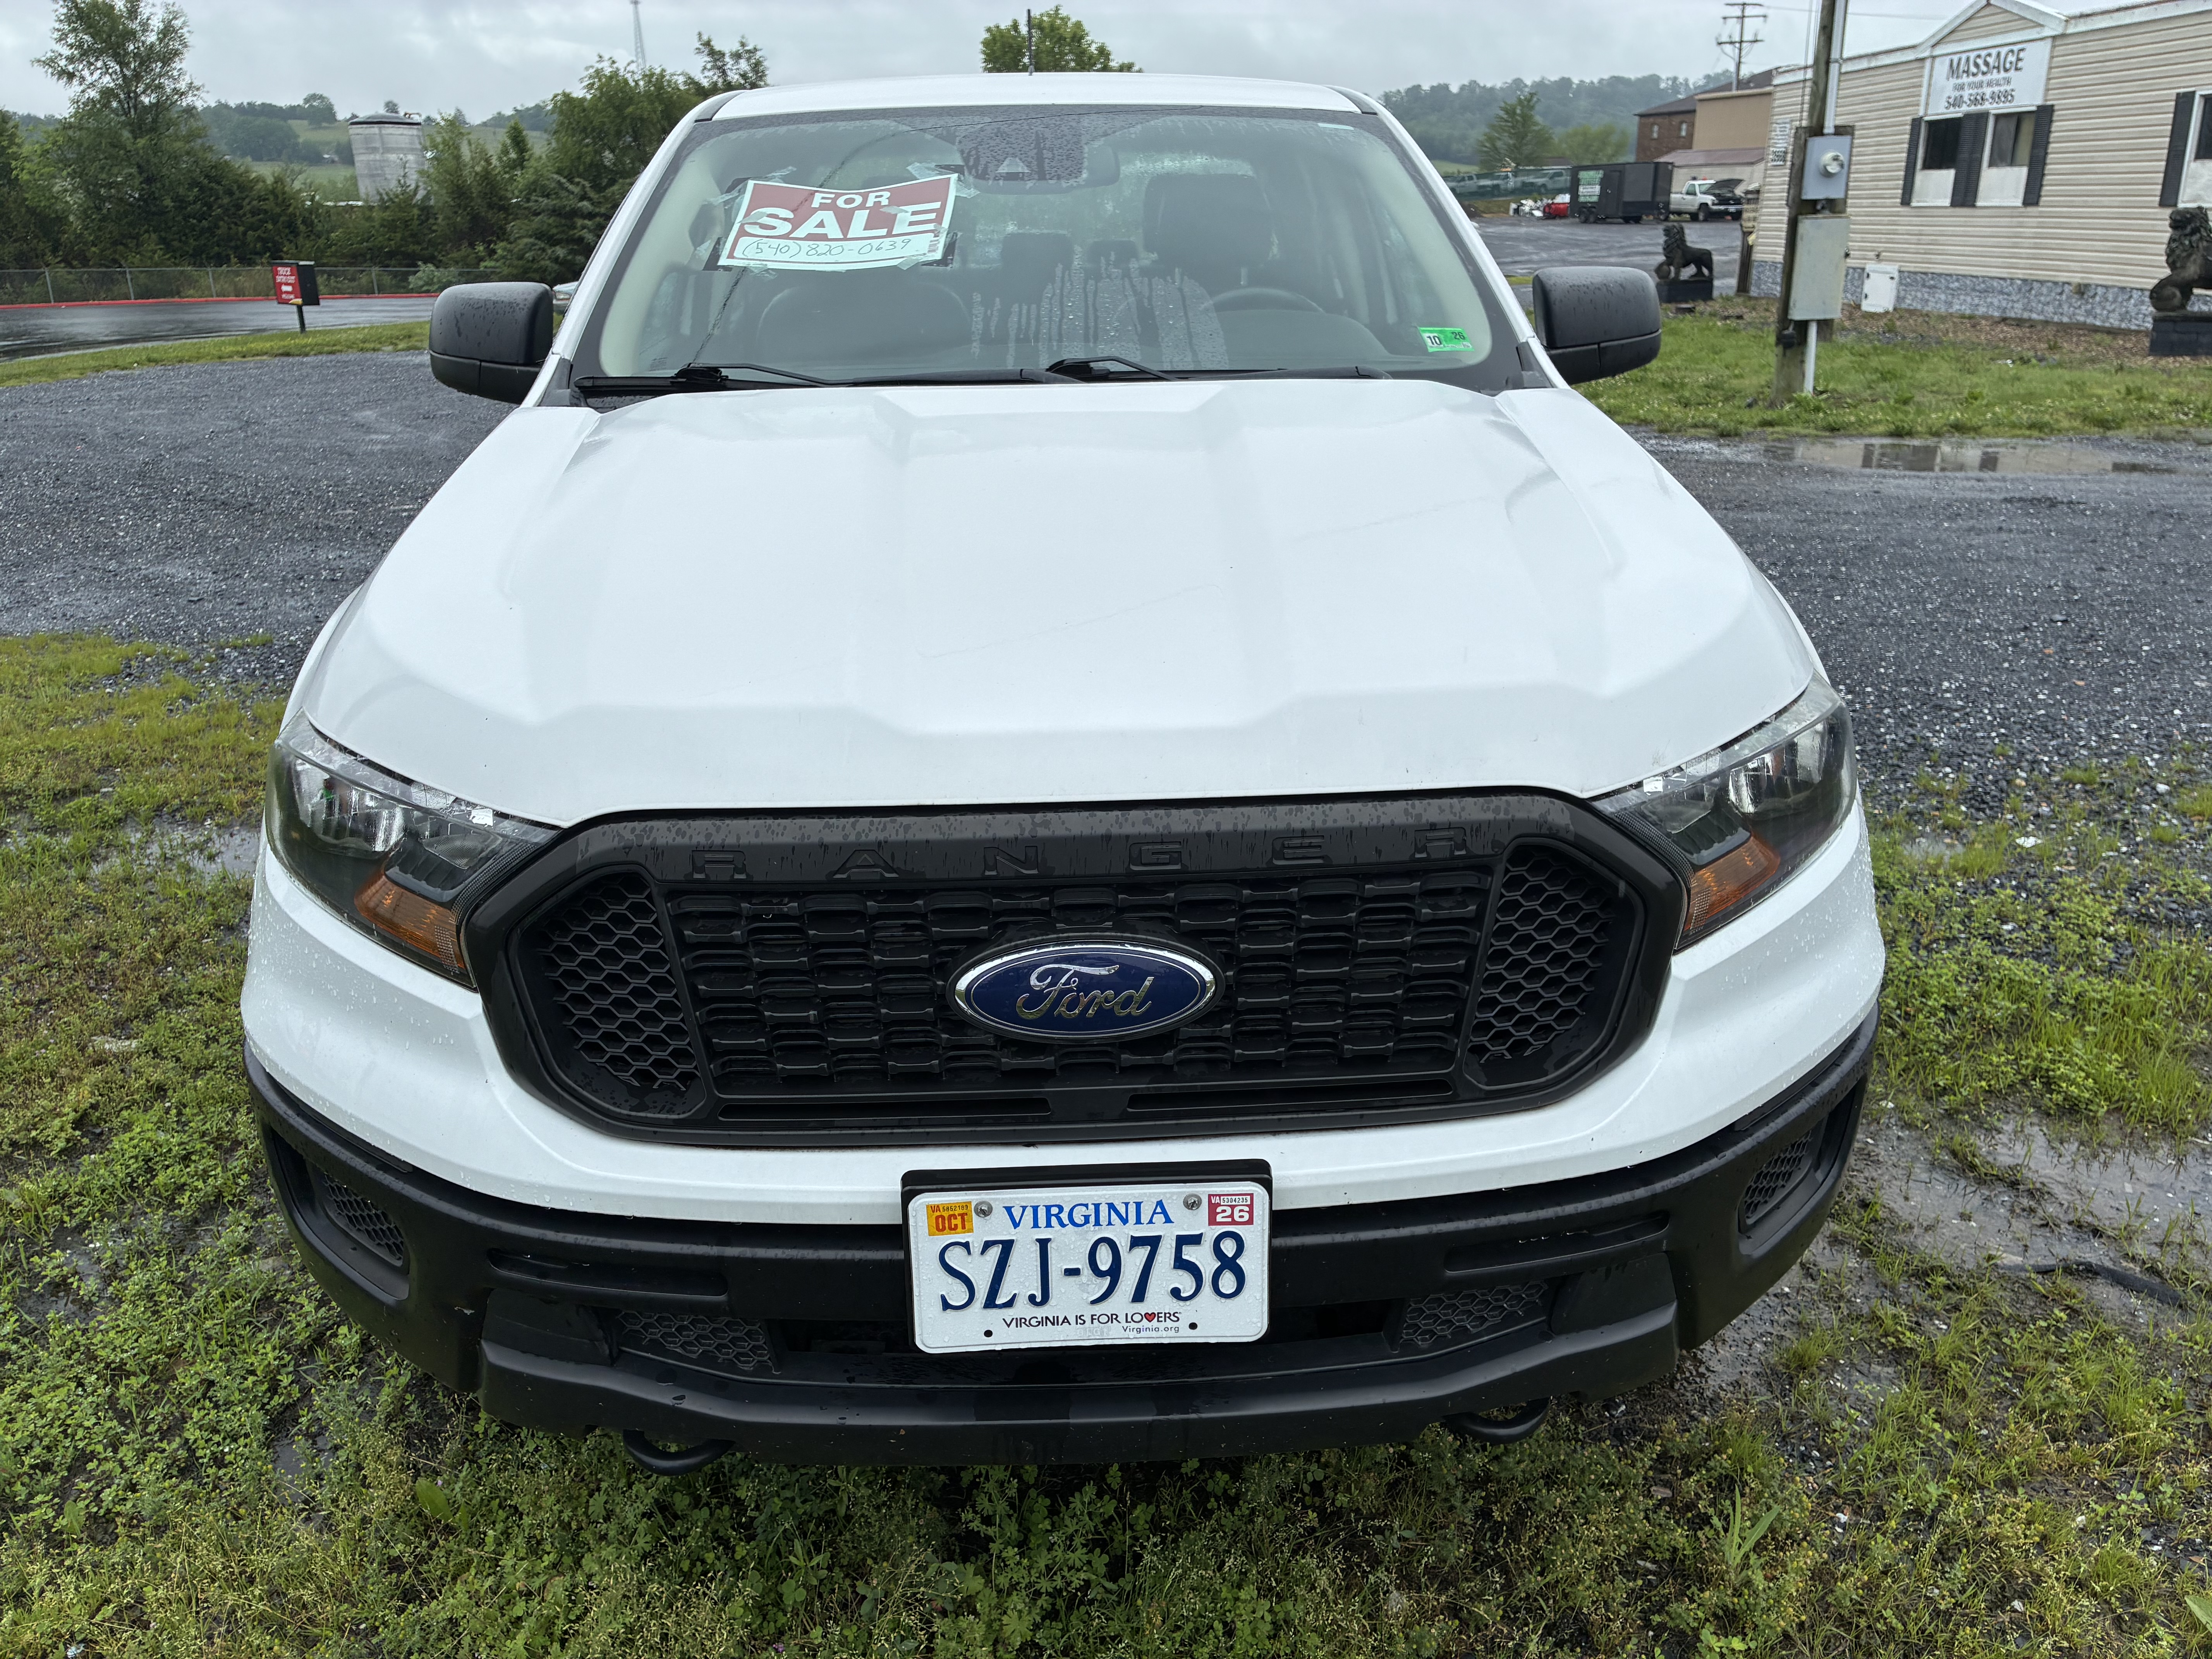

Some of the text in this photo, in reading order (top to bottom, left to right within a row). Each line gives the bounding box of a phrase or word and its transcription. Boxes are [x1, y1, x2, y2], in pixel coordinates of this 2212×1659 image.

[1946, 47, 2026, 81] MASSAGE
[1953, 77, 2012, 92] FOR YOUR HEALTH
[811, 191, 891, 209] FOR
[744, 201, 941, 239] SALE
[1426, 335, 1442, 345] 10
[1451, 331, 1466, 340] 26
[691, 826, 1467, 879] RANGER
[1016, 964, 1154, 1020] Ford
[1211, 1195, 1220, 1204] VA
[930, 1205, 941, 1213] VA
[1003, 1199, 1174, 1230] VIRGINIA
[1216, 1206, 1249, 1222] 26
[935, 1212, 968, 1232] OCT
[938, 1230, 1246, 1311] SZJ-9758
[1003, 1315, 1071, 1328] VIRGINIA
[1075, 1314, 1086, 1325] IS
[1091, 1313, 1121, 1325] FOR
[1121, 1325, 1180, 1334] Virginia.org
